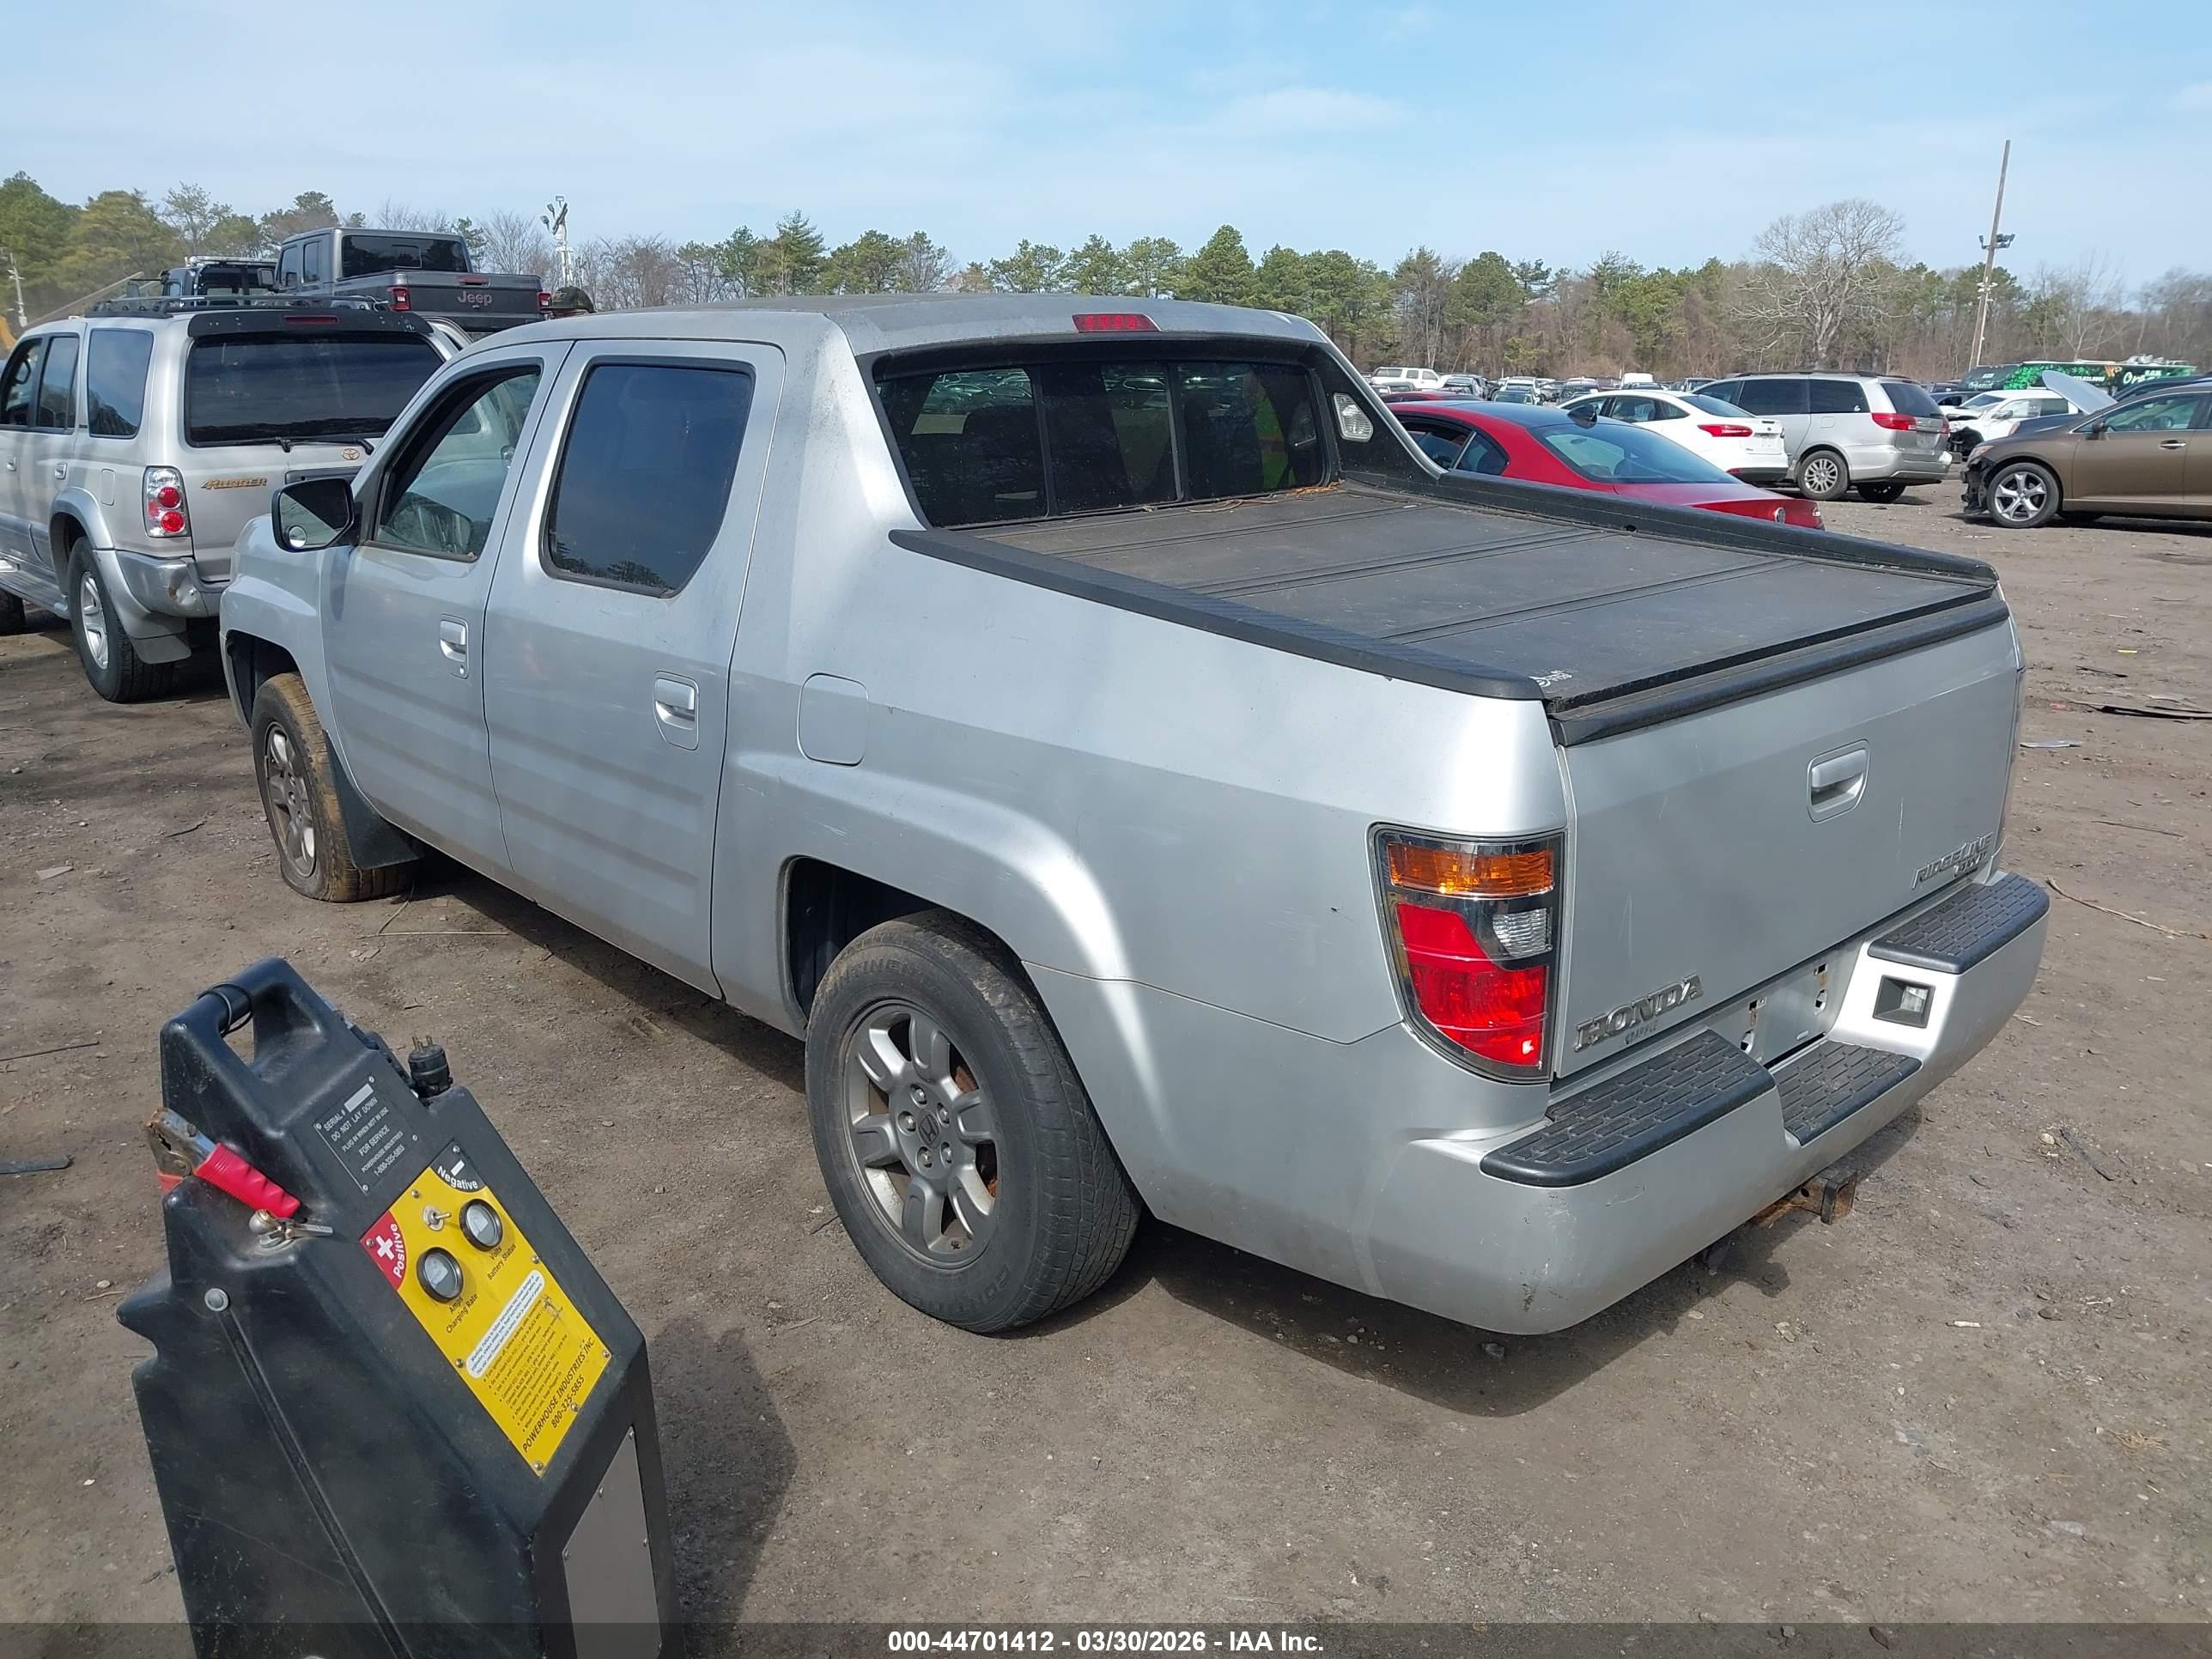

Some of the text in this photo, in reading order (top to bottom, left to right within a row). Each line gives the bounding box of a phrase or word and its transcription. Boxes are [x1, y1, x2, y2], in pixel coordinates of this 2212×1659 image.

[457, 291, 493, 306] Jeep
[1574, 973, 1705, 1052] HONDA
[323, 1113, 343, 1132] SERIAL
[331, 1097, 378, 1142] DO NOT LAY DOWN
[358, 1125, 390, 1156] FOR SERVICE
[437, 1165, 478, 1189] Negative
[392, 1223, 406, 1279] Positive
[487, 1245, 516, 1280] Battery Status
[489, 1246, 502, 1261] Volts
[446, 1293, 479, 1334] Charging Rate
[449, 1297, 464, 1314] Amps
[522, 1395, 557, 1453] POWERHOUSE
[556, 1352, 586, 1400] INDUSTRIES
[583, 1337, 595, 1356] INC
[551, 1375, 585, 1428] 800-325-5855
